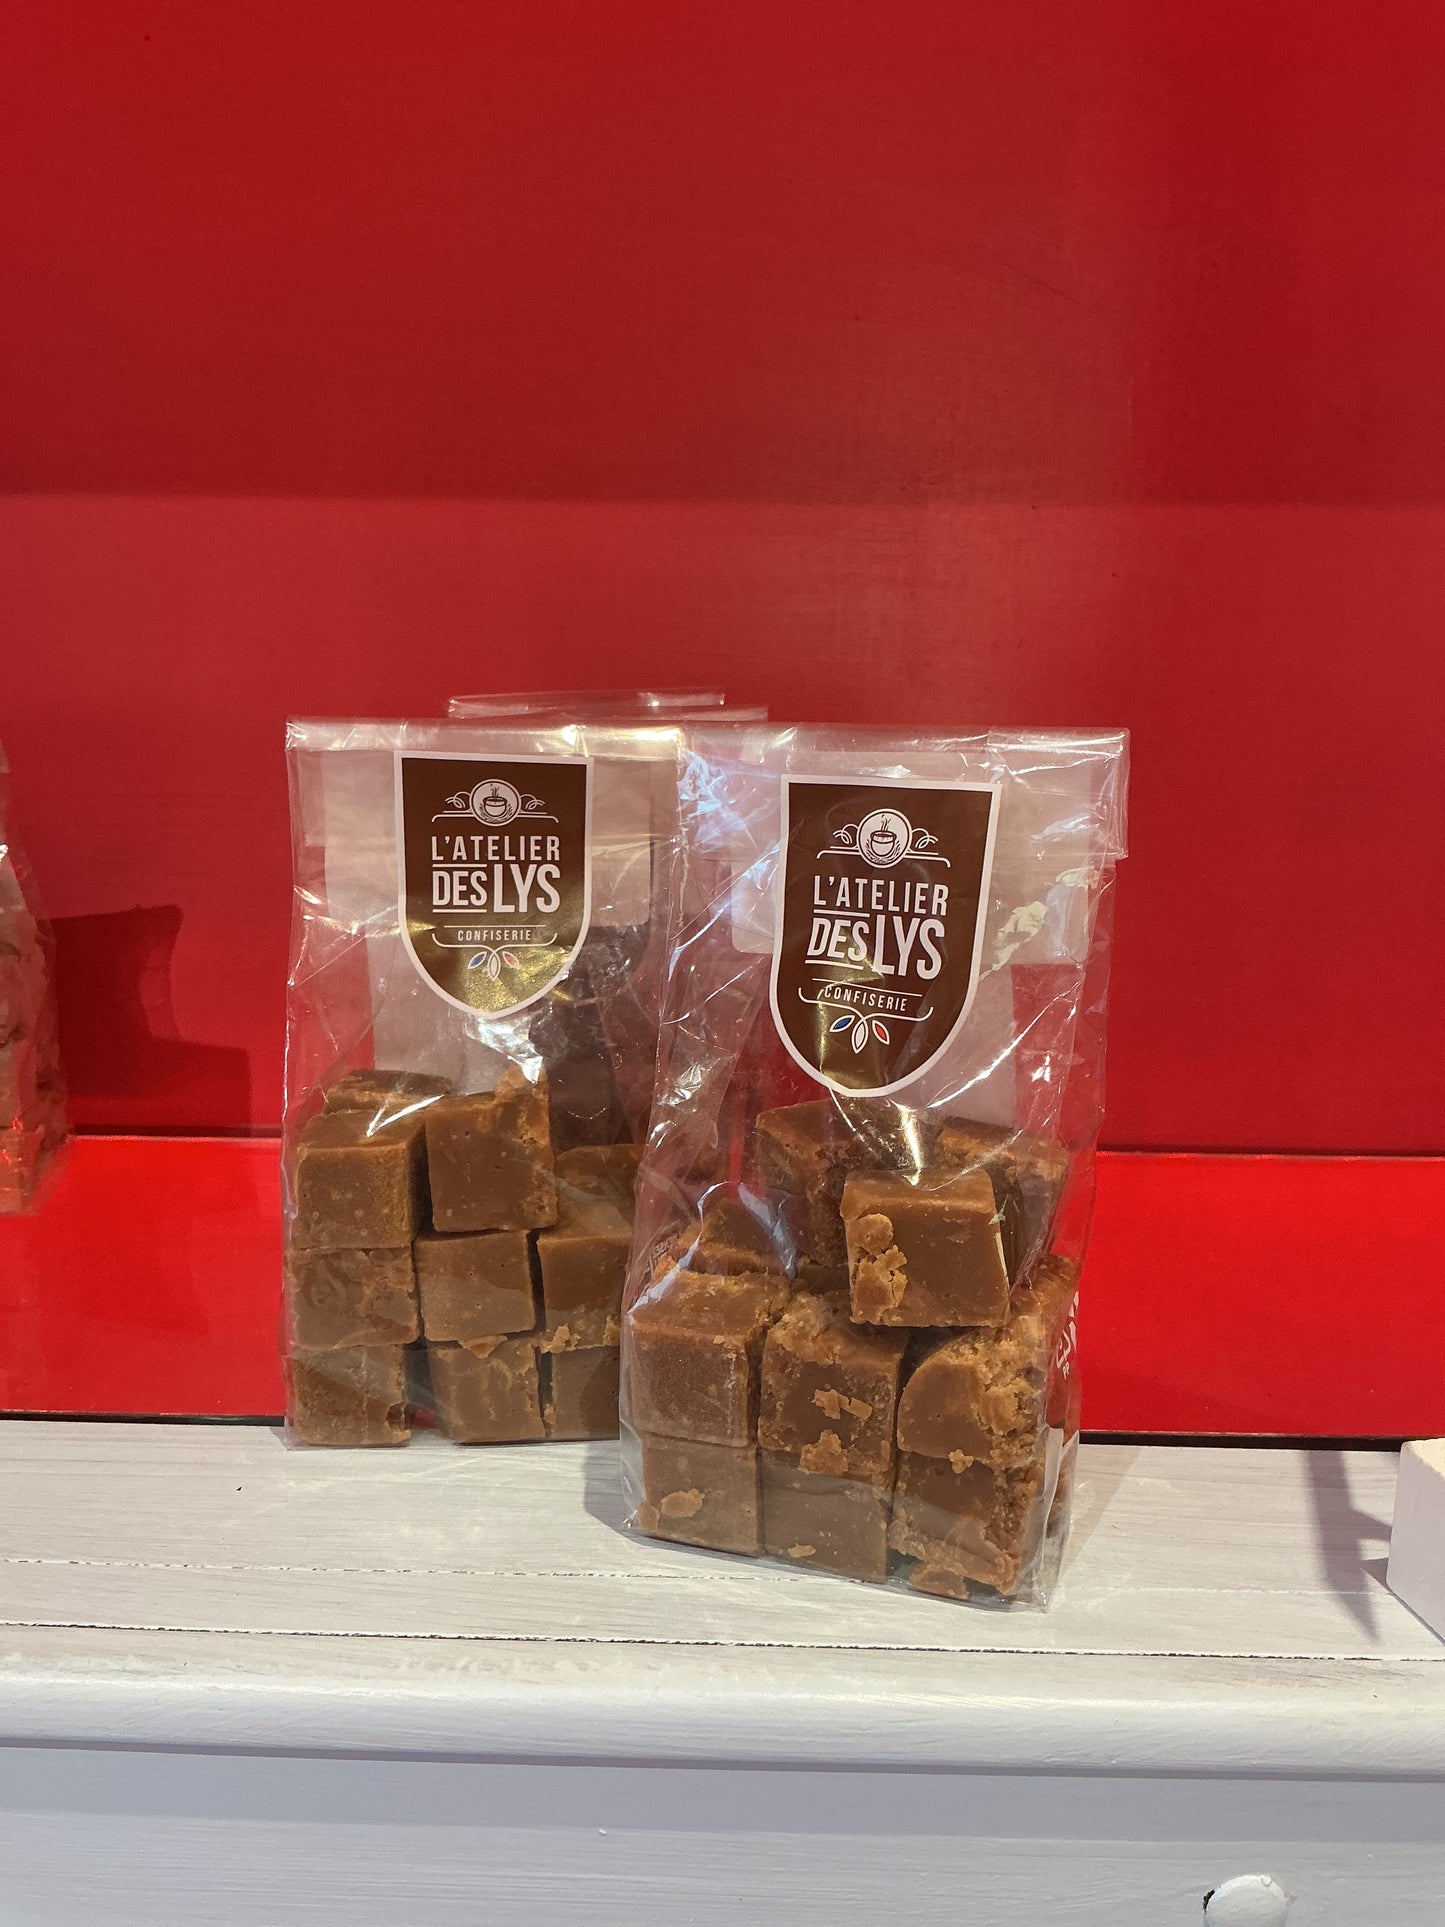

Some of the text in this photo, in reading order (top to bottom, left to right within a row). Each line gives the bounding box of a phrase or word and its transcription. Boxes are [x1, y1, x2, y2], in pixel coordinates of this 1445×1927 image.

[431, 835, 560, 861] L'ATELIER
[493, 863, 561, 913] LYS
[813, 875, 949, 916] L'ATELIER
[457, 929, 532, 941] CONFISERIE
[872, 914, 945, 980] LYS
[824, 985, 907, 1012] CONFISERIE
